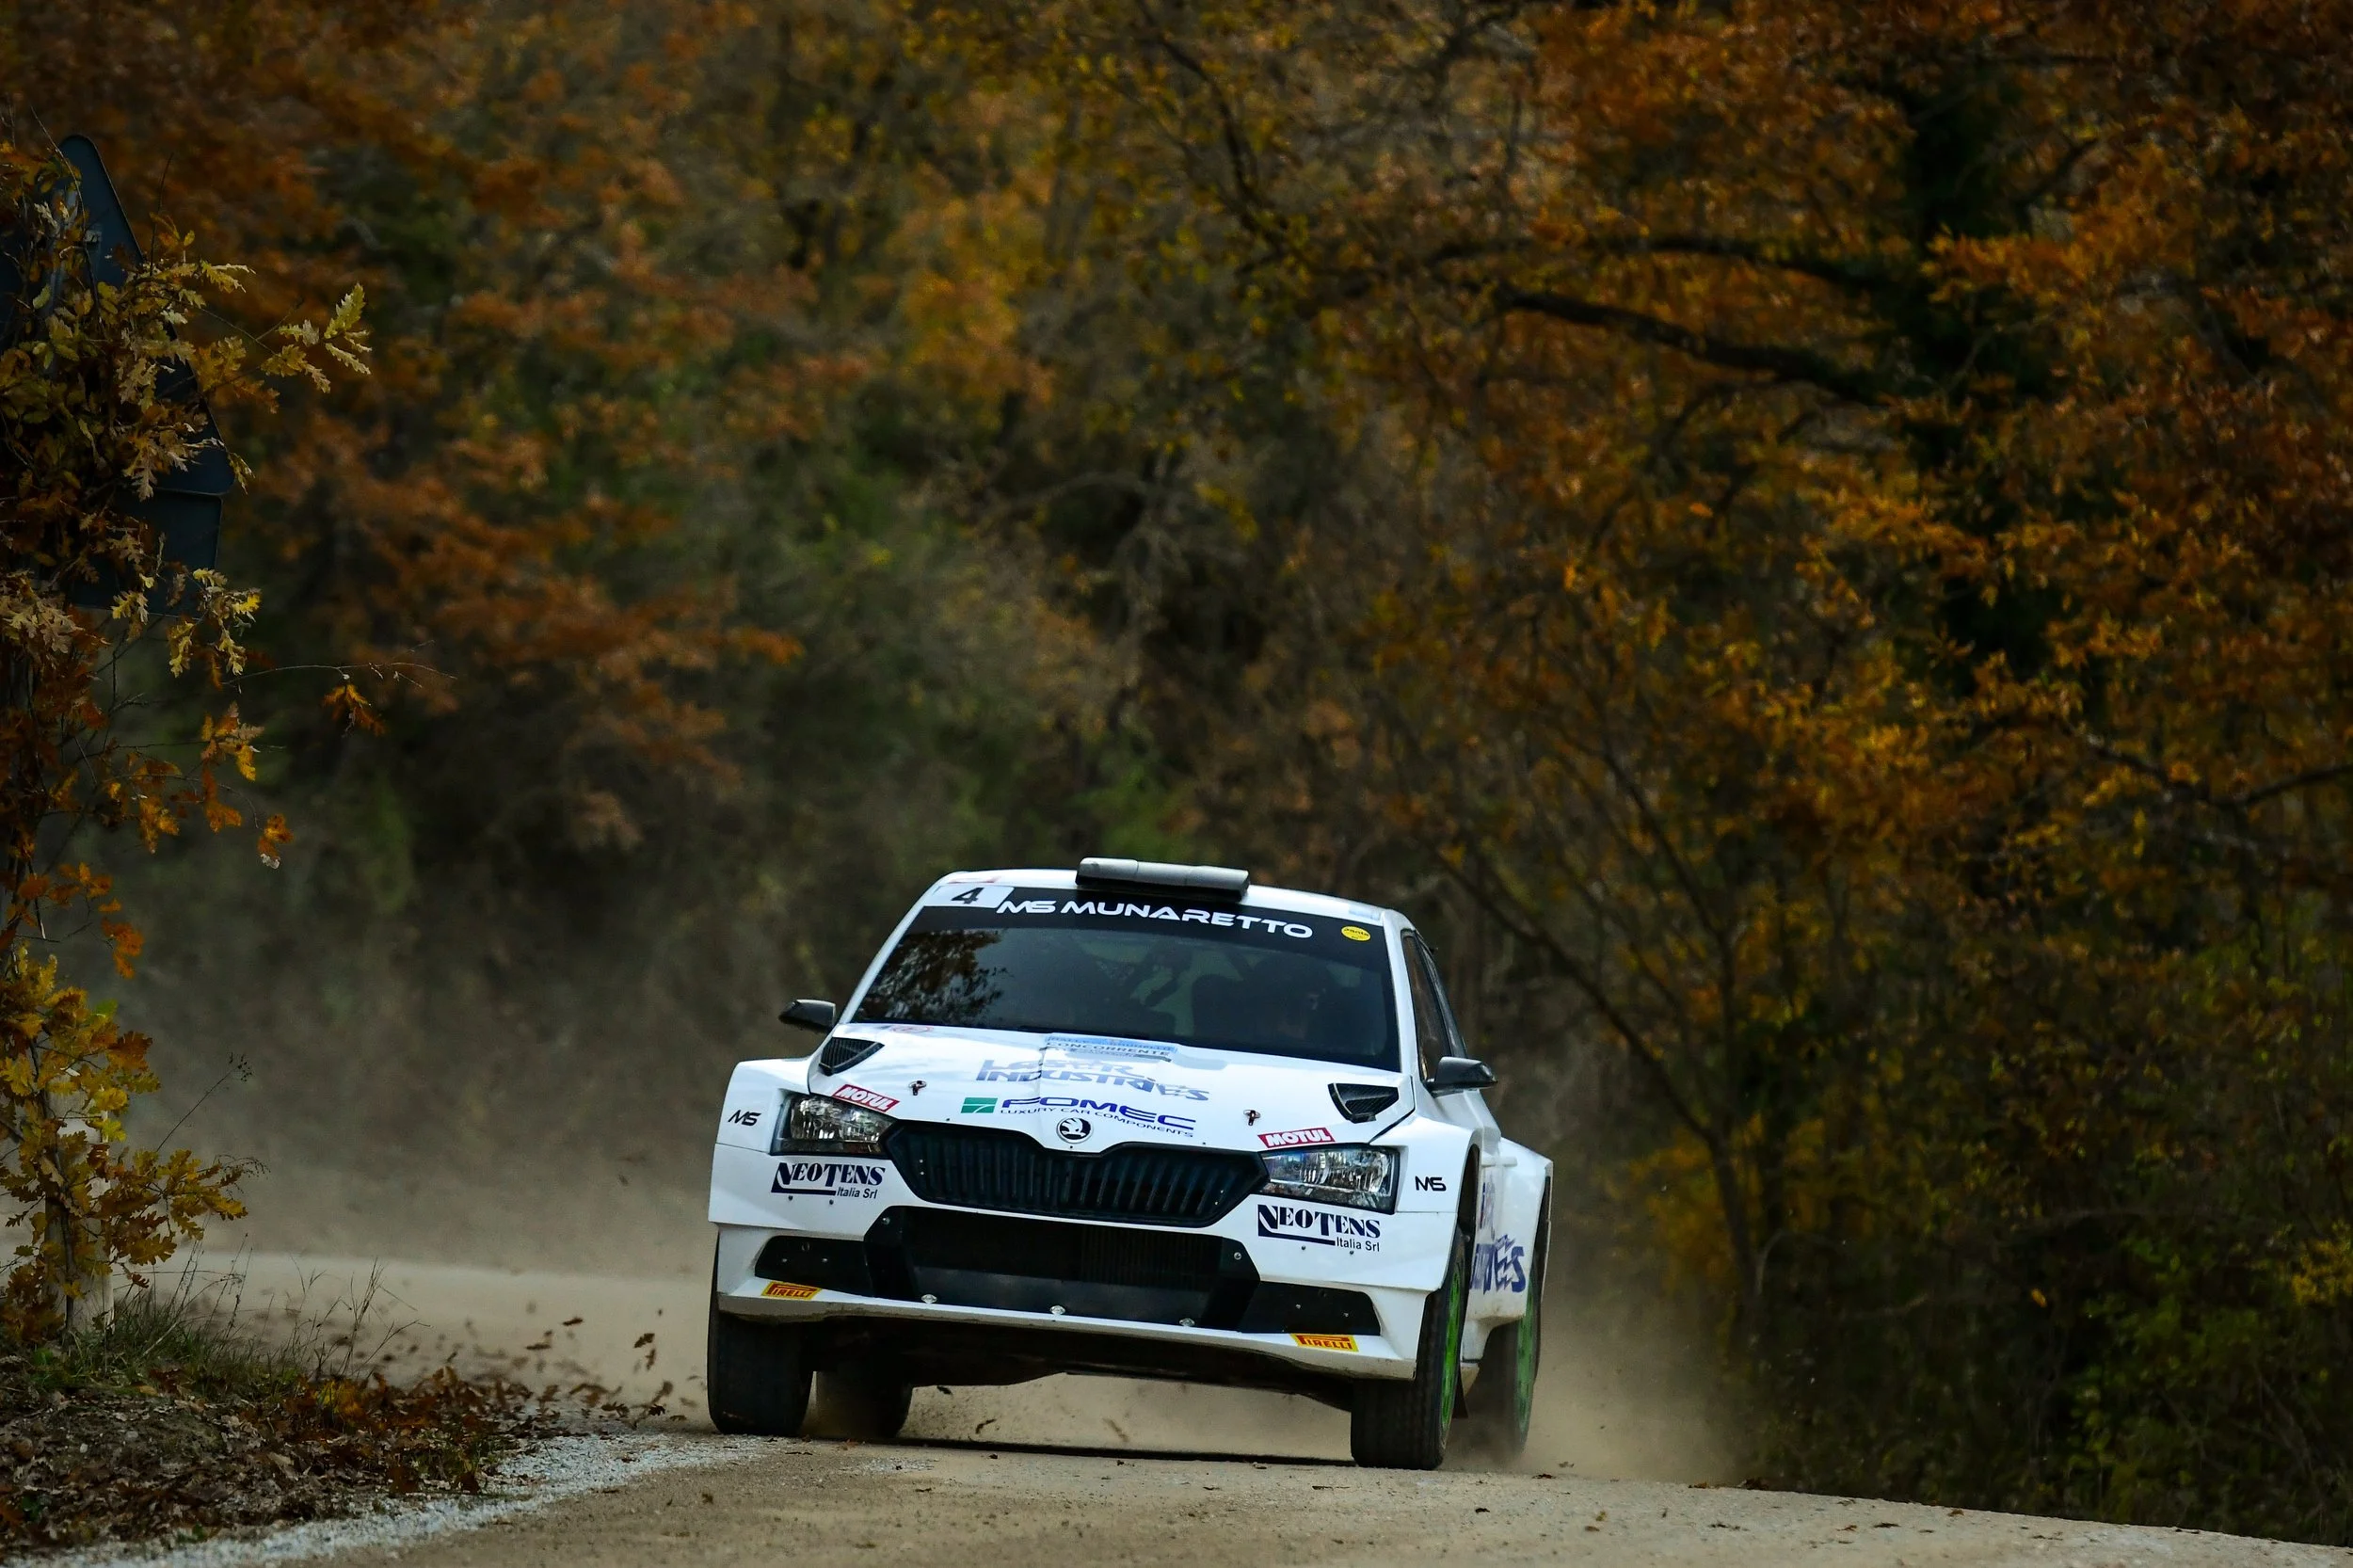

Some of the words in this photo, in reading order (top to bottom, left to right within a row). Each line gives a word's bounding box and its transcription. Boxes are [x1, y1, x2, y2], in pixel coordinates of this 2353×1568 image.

[951, 888, 984, 904] 4
[996, 901, 1057, 914] MS
[1061, 901, 1314, 938] MUNARETTO
[1046, 1041, 1170, 1058] CONCORRENTE
[975, 1068, 1209, 1101] INDUSTRIES
[834, 1085, 897, 1112] MOTUL
[727, 1110, 761, 1127] MS
[1001, 1096, 1196, 1130] FOMEC
[1095, 1111, 1193, 1138] COMPONENTS
[1264, 1128, 1334, 1148] MOTUL
[771, 1162, 886, 1189] NEOTENS
[1414, 1176, 1448, 1192] MS
[836, 1187, 860, 1198] Italia
[862, 1189, 878, 1200] Srl
[1257, 1204, 1381, 1240] NEOTENS
[1336, 1236, 1362, 1250] Italia
[1365, 1240, 1381, 1253] Srl
[765, 1283, 818, 1299] PIRELLI
[1296, 1335, 1353, 1350] PIRELLI
